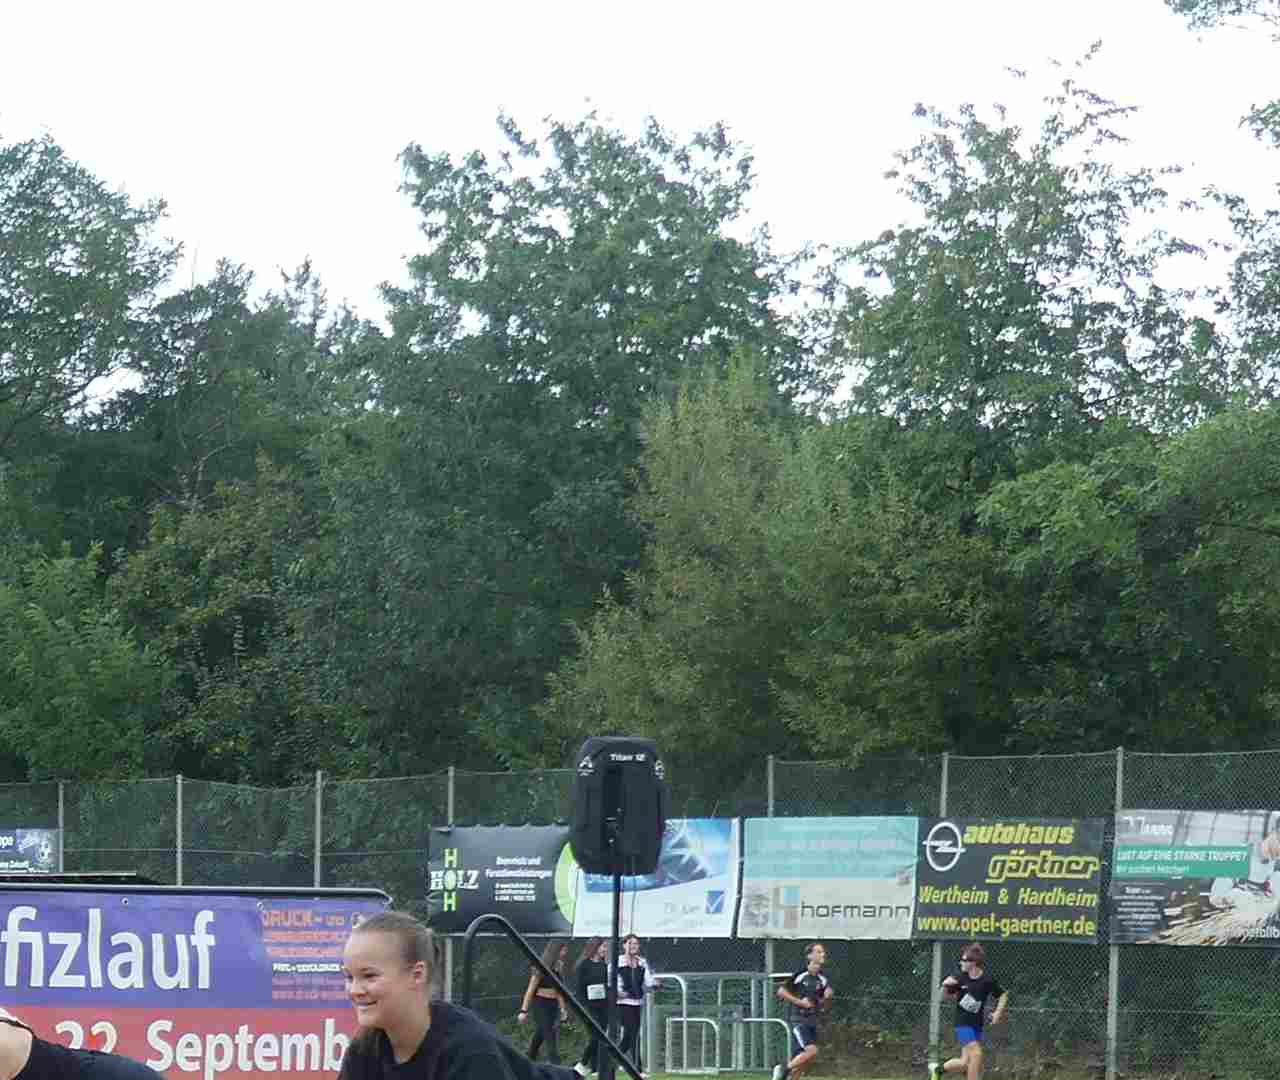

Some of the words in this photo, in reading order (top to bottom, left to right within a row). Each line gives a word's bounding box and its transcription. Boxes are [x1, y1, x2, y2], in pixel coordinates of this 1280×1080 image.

[963, 822, 1075, 845] autohaus
[985, 849, 1101, 883] gärtner
[919, 885, 989, 905] Wertheim
[997, 888, 1009, 905] &
[1016, 887, 1099, 907] Hardheim
[917, 913, 1097, 938] www.opel-gaertner.de
[55, 1019, 119, 1055] 22
